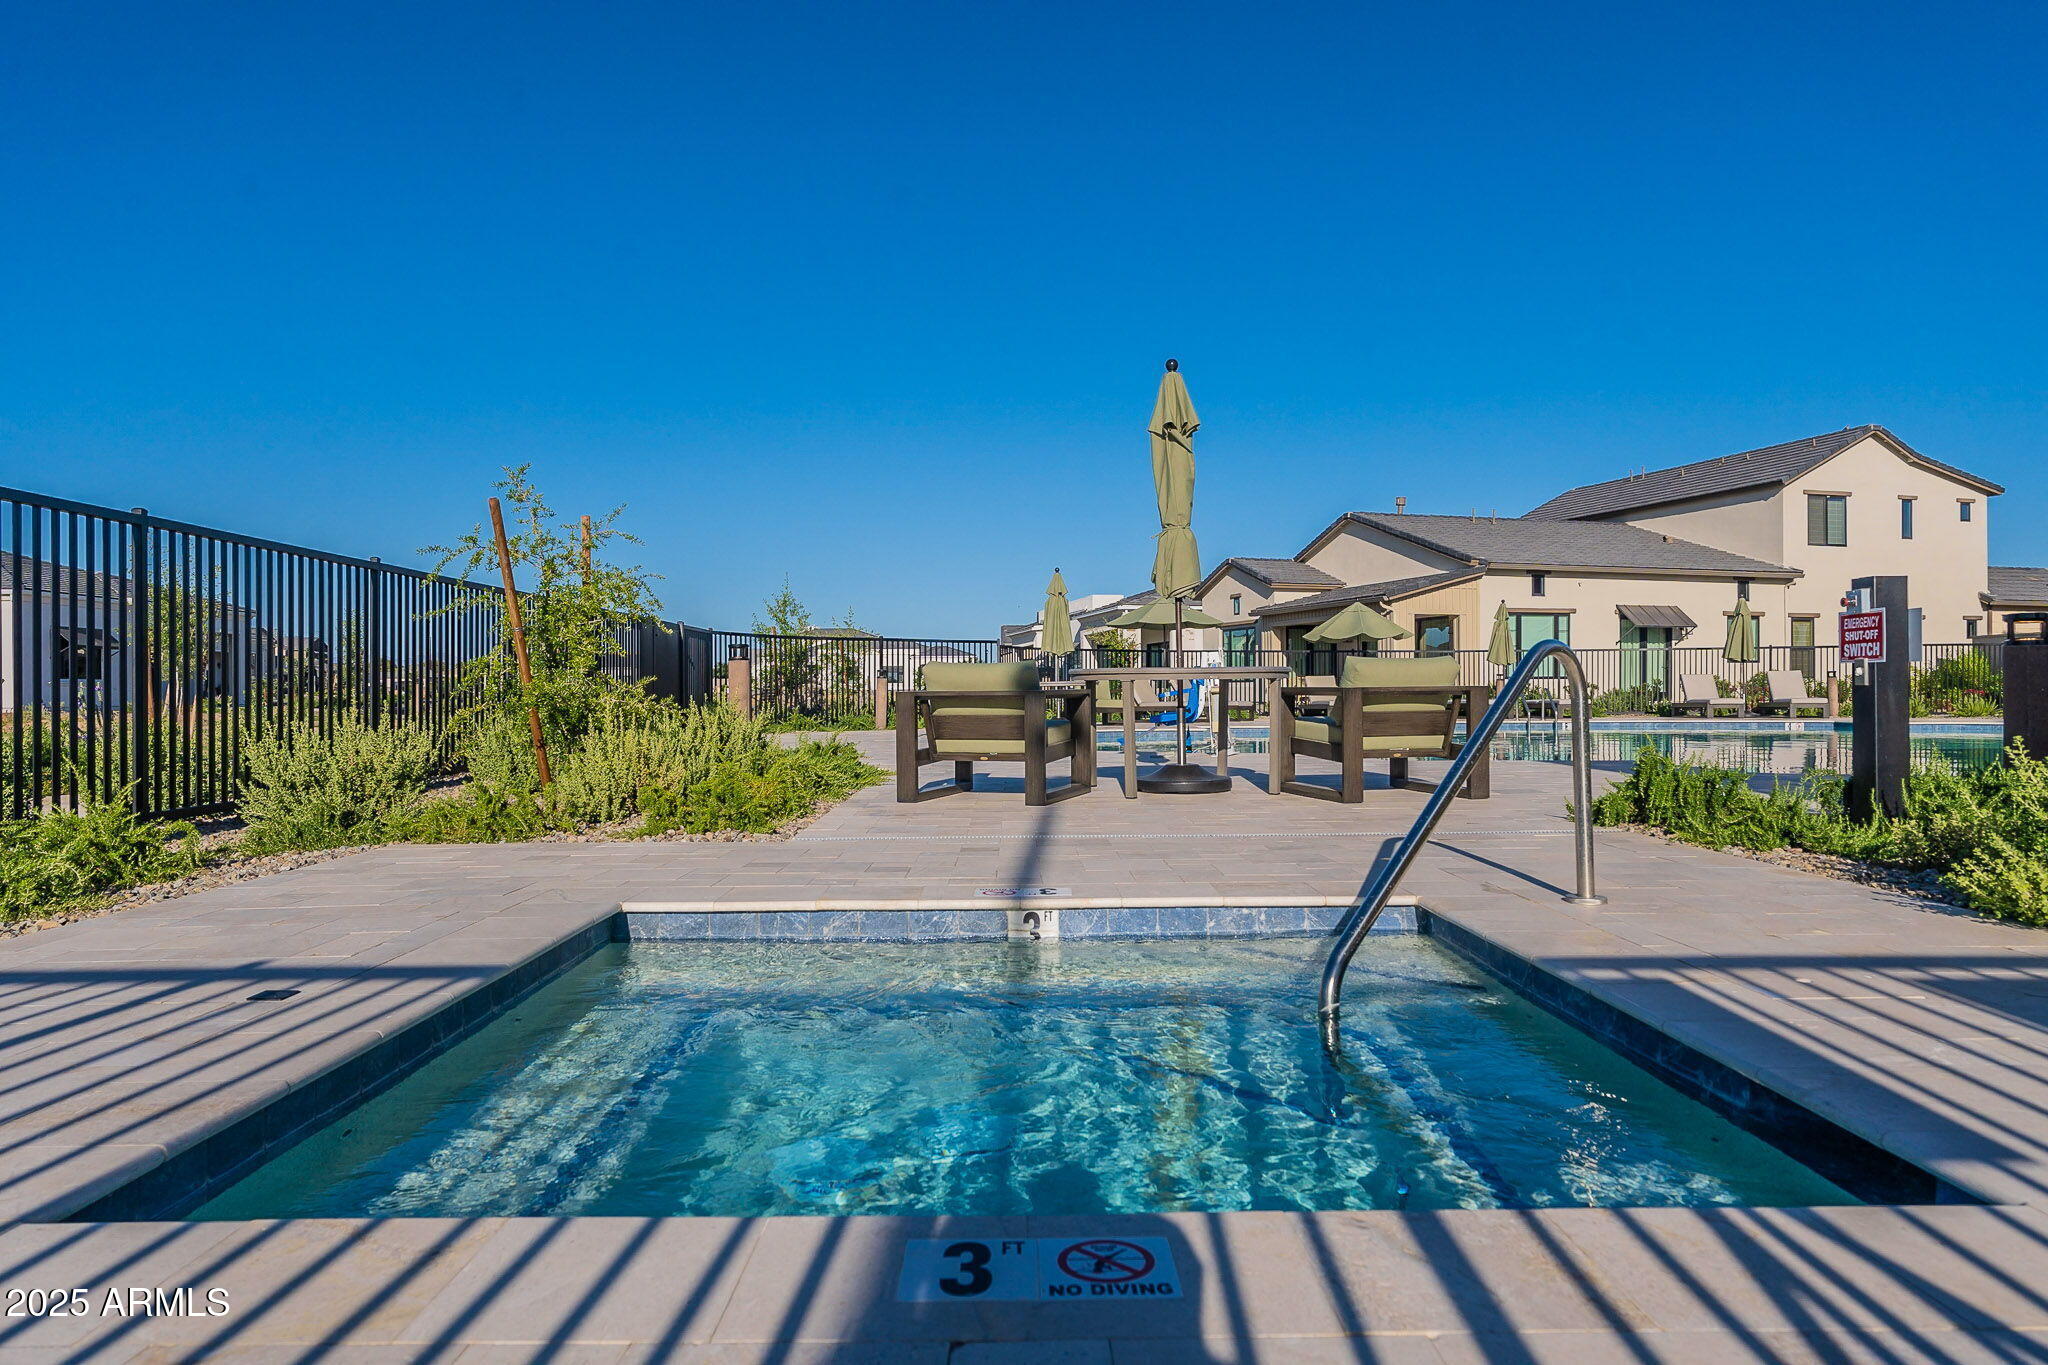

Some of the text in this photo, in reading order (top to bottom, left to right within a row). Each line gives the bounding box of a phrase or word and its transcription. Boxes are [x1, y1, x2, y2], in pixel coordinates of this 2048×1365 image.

[1843, 615, 1880, 630] EMERGENCY
[1844, 629, 1879, 641] SHUT-OFF
[1843, 641, 1880, 657] SWITCH
[1023, 911, 1053, 941] 3 FT
[939, 1240, 1025, 1297] 3 FT
[1048, 1282, 1174, 1297] NO DIVING
